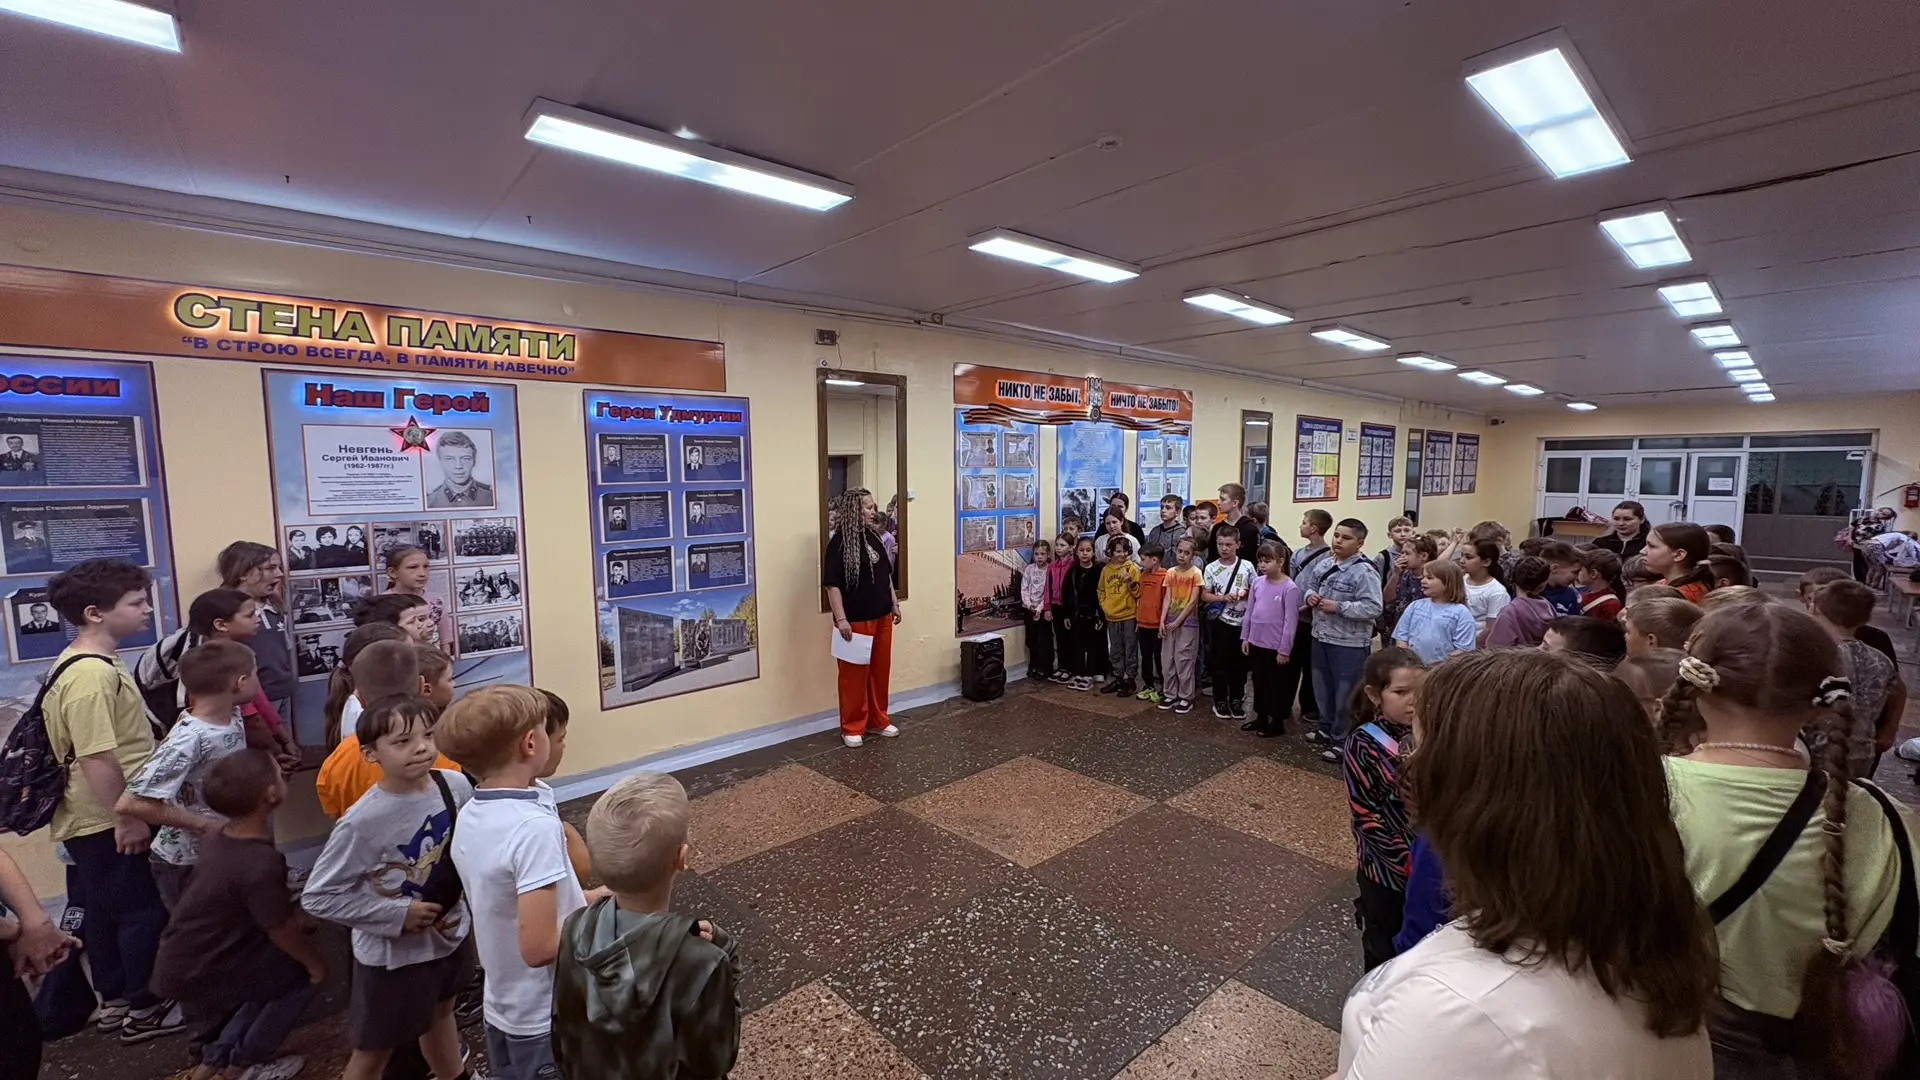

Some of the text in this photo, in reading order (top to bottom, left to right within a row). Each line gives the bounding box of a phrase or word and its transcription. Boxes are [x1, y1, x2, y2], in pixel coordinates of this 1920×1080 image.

[174, 292, 576, 361] СТЕНА ПАМЯТИ
[216, 339, 298, 355] СТРОЮ
[305, 346, 391, 365] ВСЕГДА,
[396, 352, 409, 364] В
[415, 354, 488, 370] ПАМЯТИ
[304, 382, 490, 415] Наш Герой
[998, 381, 1081, 404] НИКТО НЕ ЗАБЫТ,
[1110, 393, 1179, 411] НИЧТО НЕ ЗАБЫТО!
[596, 402, 742, 424] Герои Удмуртии
[322, 454, 410, 463] Сергей Иванович
[338, 444, 394, 454] Невгень
